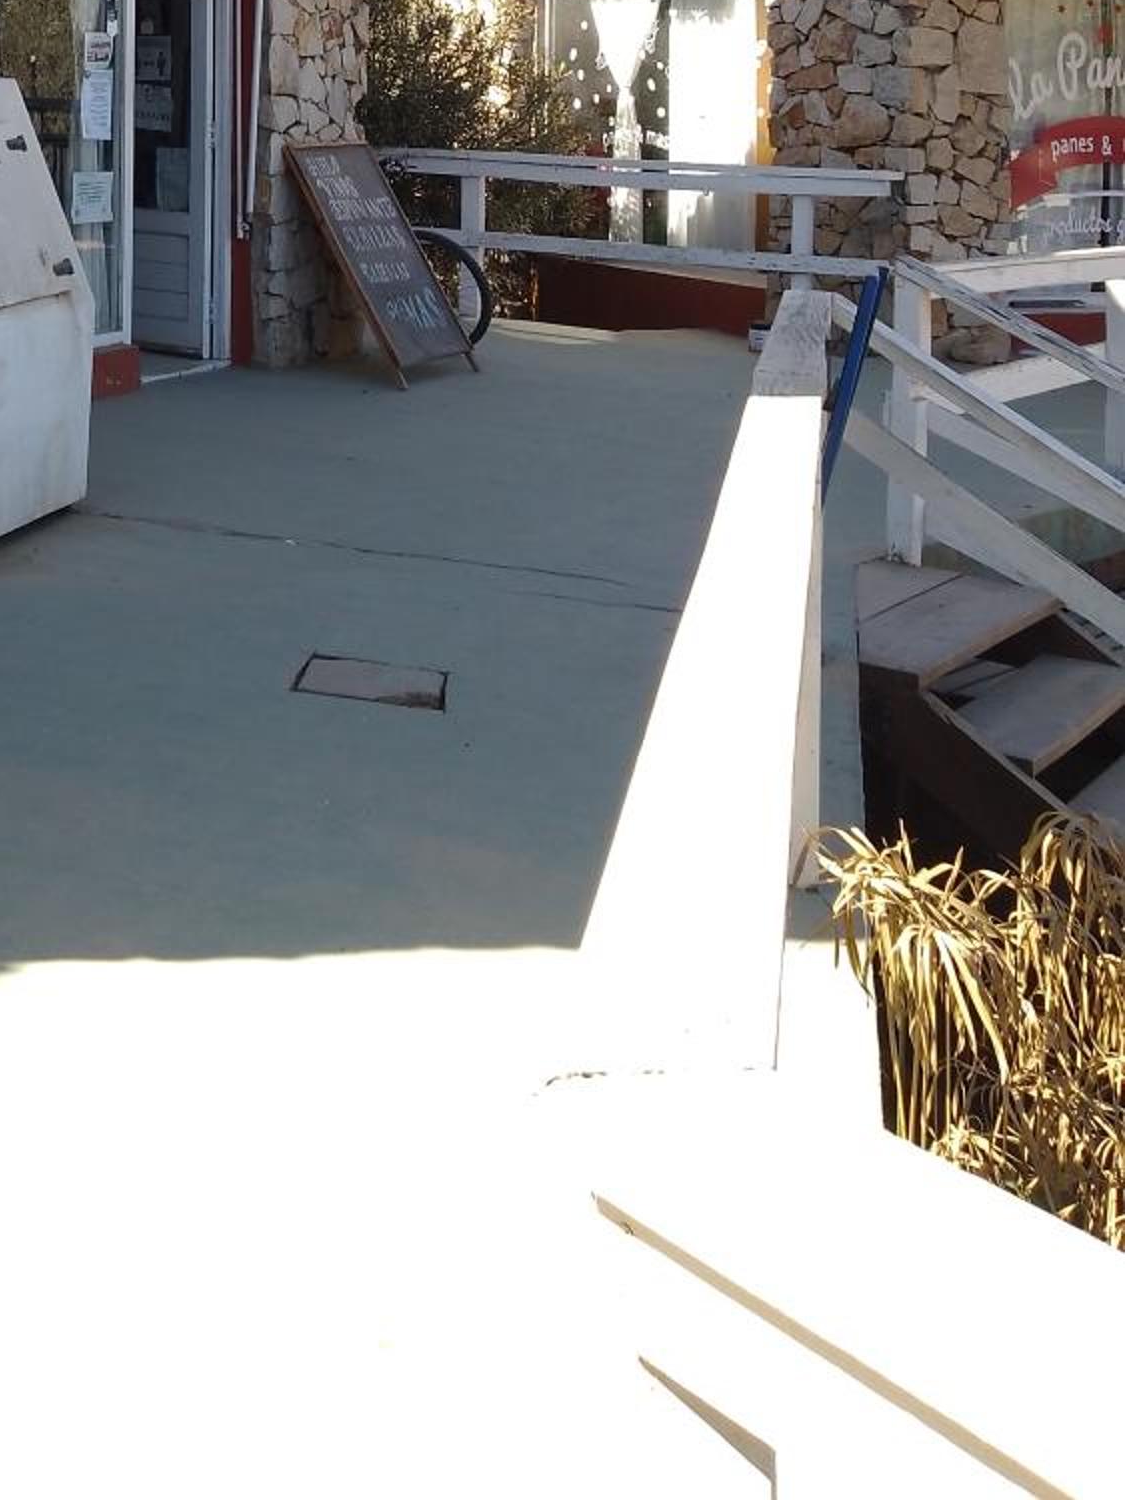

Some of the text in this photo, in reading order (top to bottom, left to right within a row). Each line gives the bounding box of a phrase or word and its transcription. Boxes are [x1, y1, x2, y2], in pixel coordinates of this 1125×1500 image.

[1008, 56, 1053, 122] La
[1050, 134, 1113, 162] panes &
